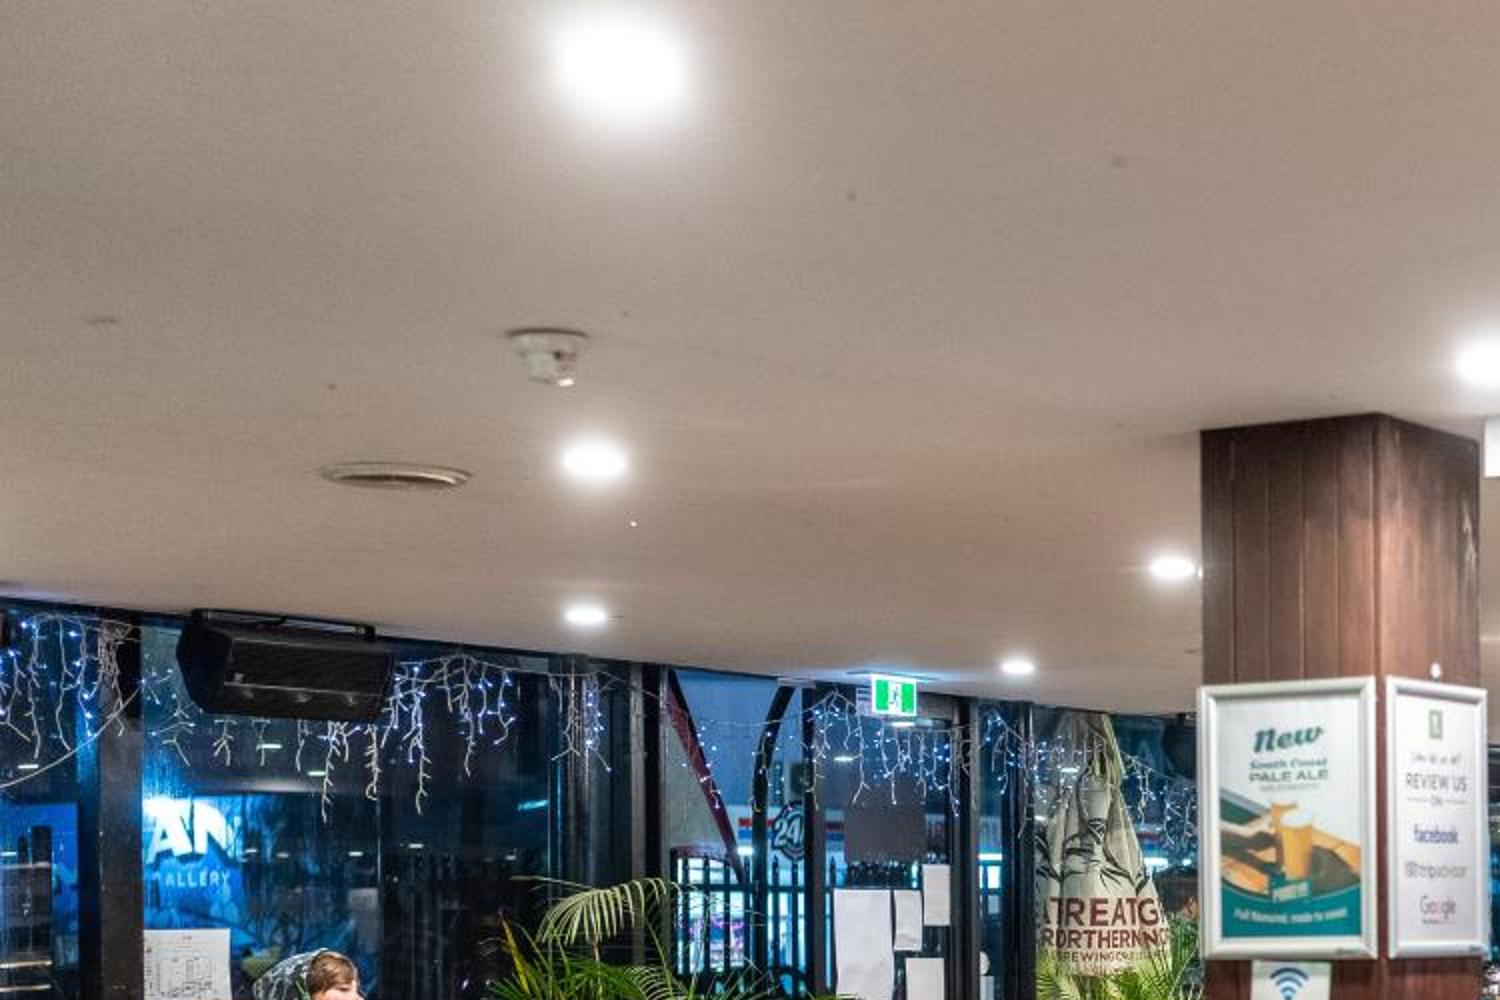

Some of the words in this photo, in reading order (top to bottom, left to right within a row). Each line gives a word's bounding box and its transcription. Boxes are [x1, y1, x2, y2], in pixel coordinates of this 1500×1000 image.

[1249, 771, 1292, 782] PALE
[1296, 769, 1329, 781] ALE
[1406, 772, 1448, 790] REVIEW
[1413, 823, 1459, 846] facebook
